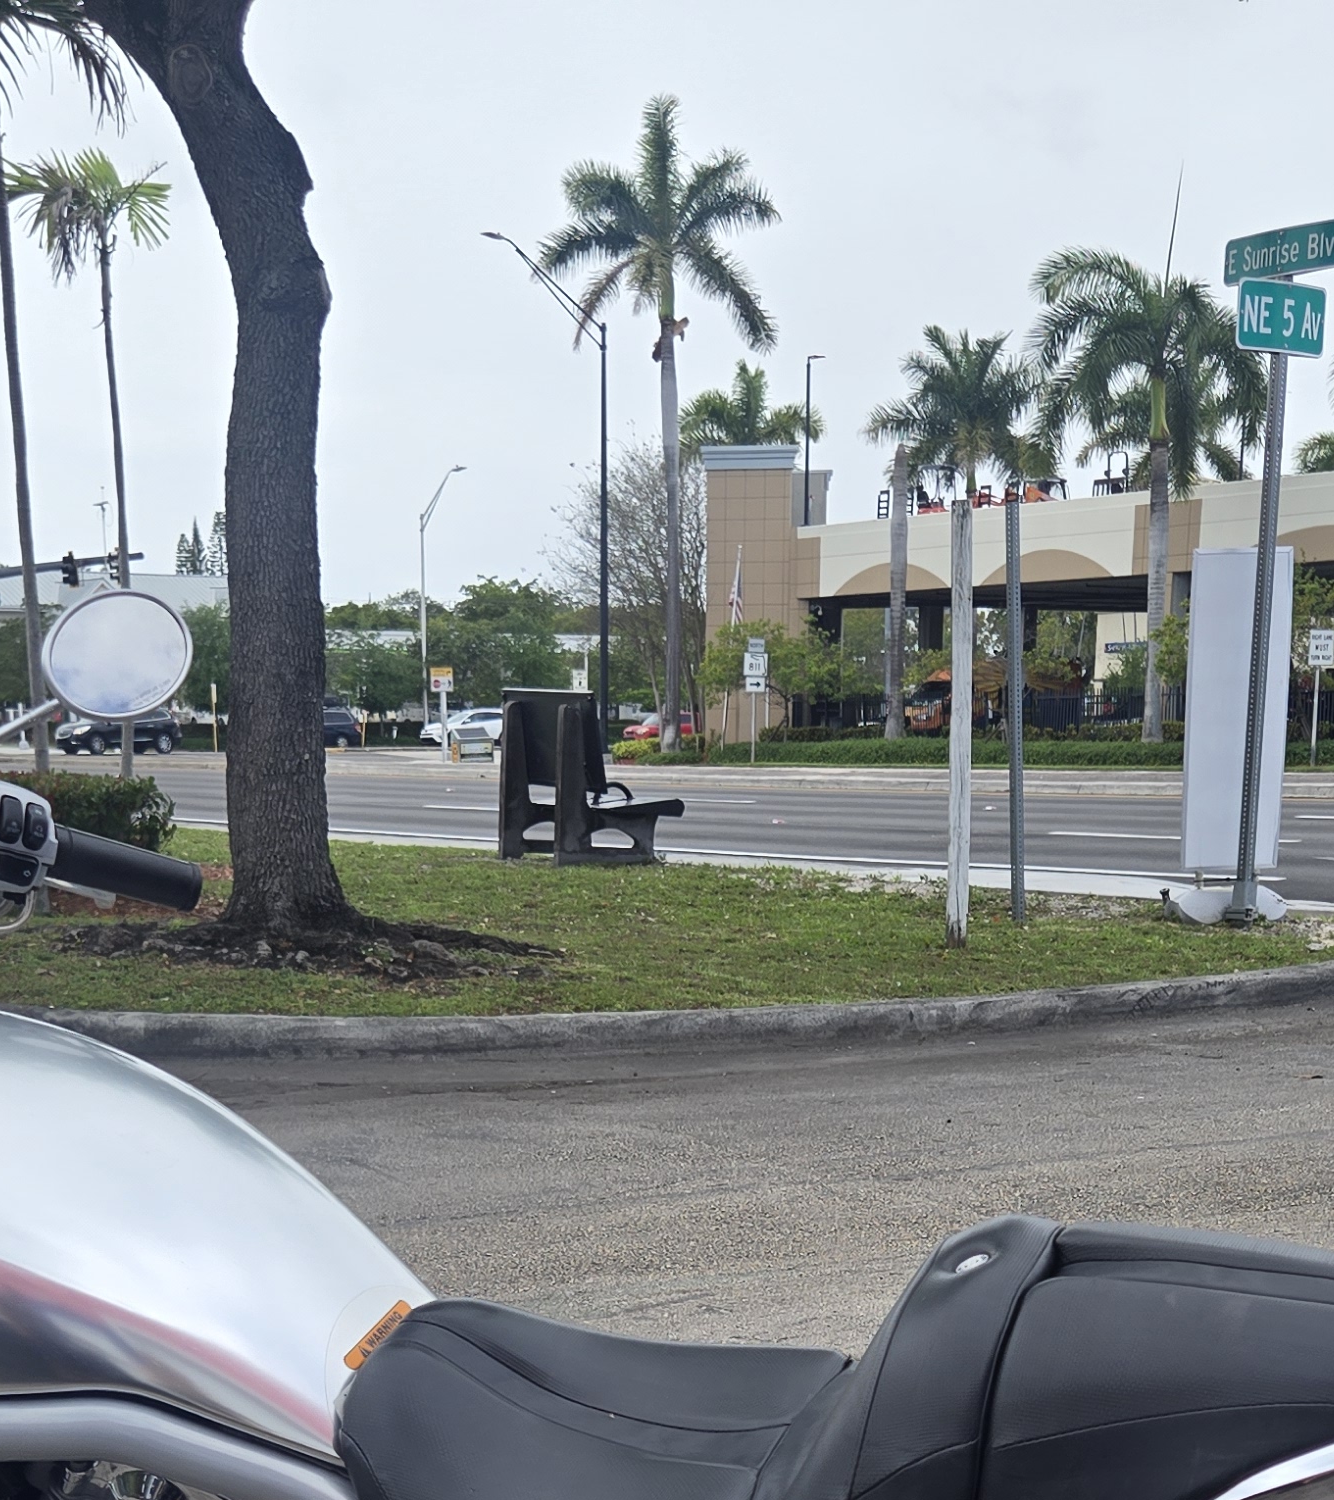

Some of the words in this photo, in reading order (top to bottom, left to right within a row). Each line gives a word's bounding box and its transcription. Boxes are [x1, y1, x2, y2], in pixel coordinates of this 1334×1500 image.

[1228, 249, 1237, 275] E
[1242, 240, 1299, 271] Sunrise
[1243, 294, 1273, 334] NE
[1282, 298, 1295, 337] 5
[748, 662, 761, 671] 811
[365, 1311, 403, 1350] WARNING
